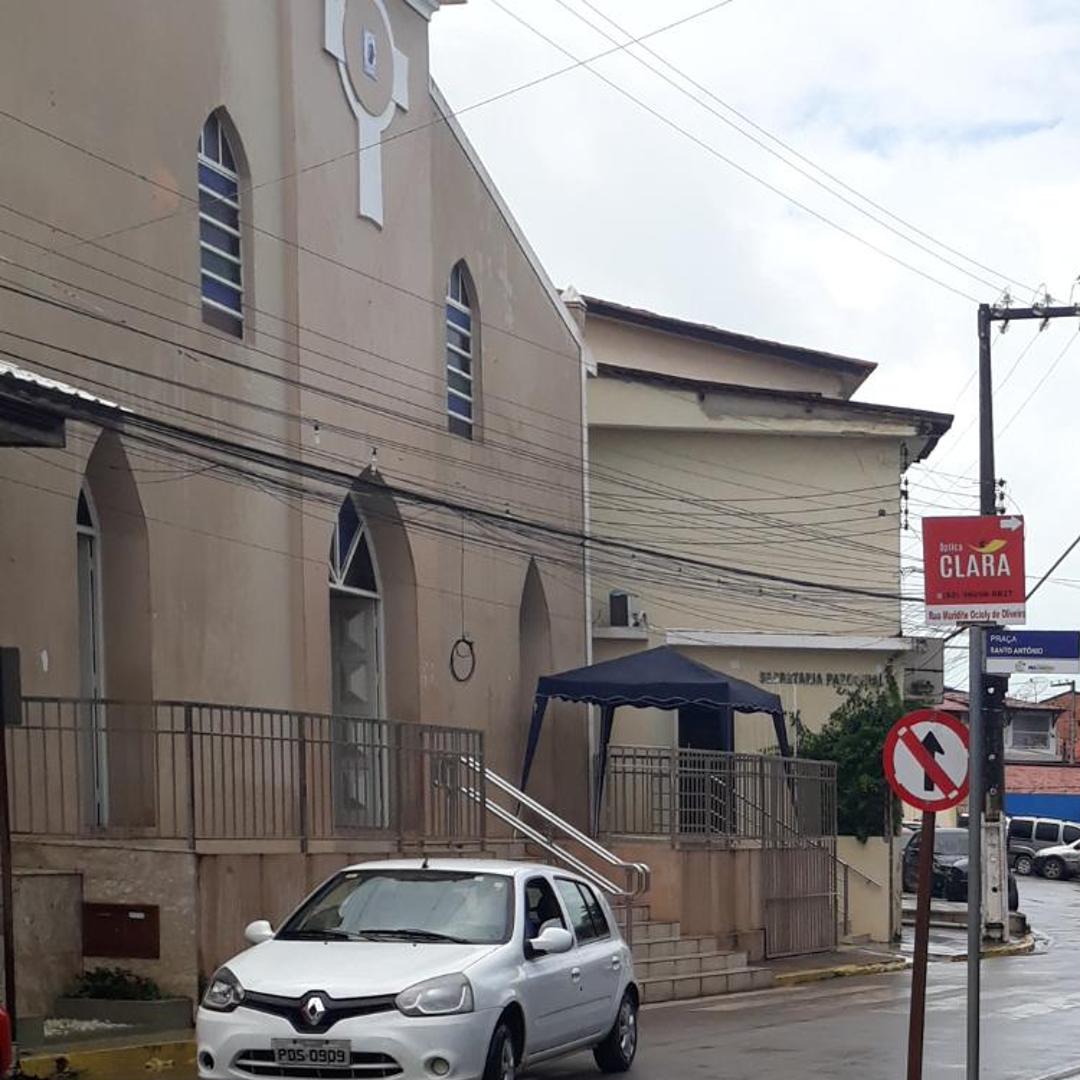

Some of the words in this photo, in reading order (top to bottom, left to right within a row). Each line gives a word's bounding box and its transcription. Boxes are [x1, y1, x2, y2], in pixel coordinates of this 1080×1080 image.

[940, 553, 1011, 578] CLARA
[990, 634, 1017, 643] PRAÇA
[990, 646, 1012, 654] SANTO
